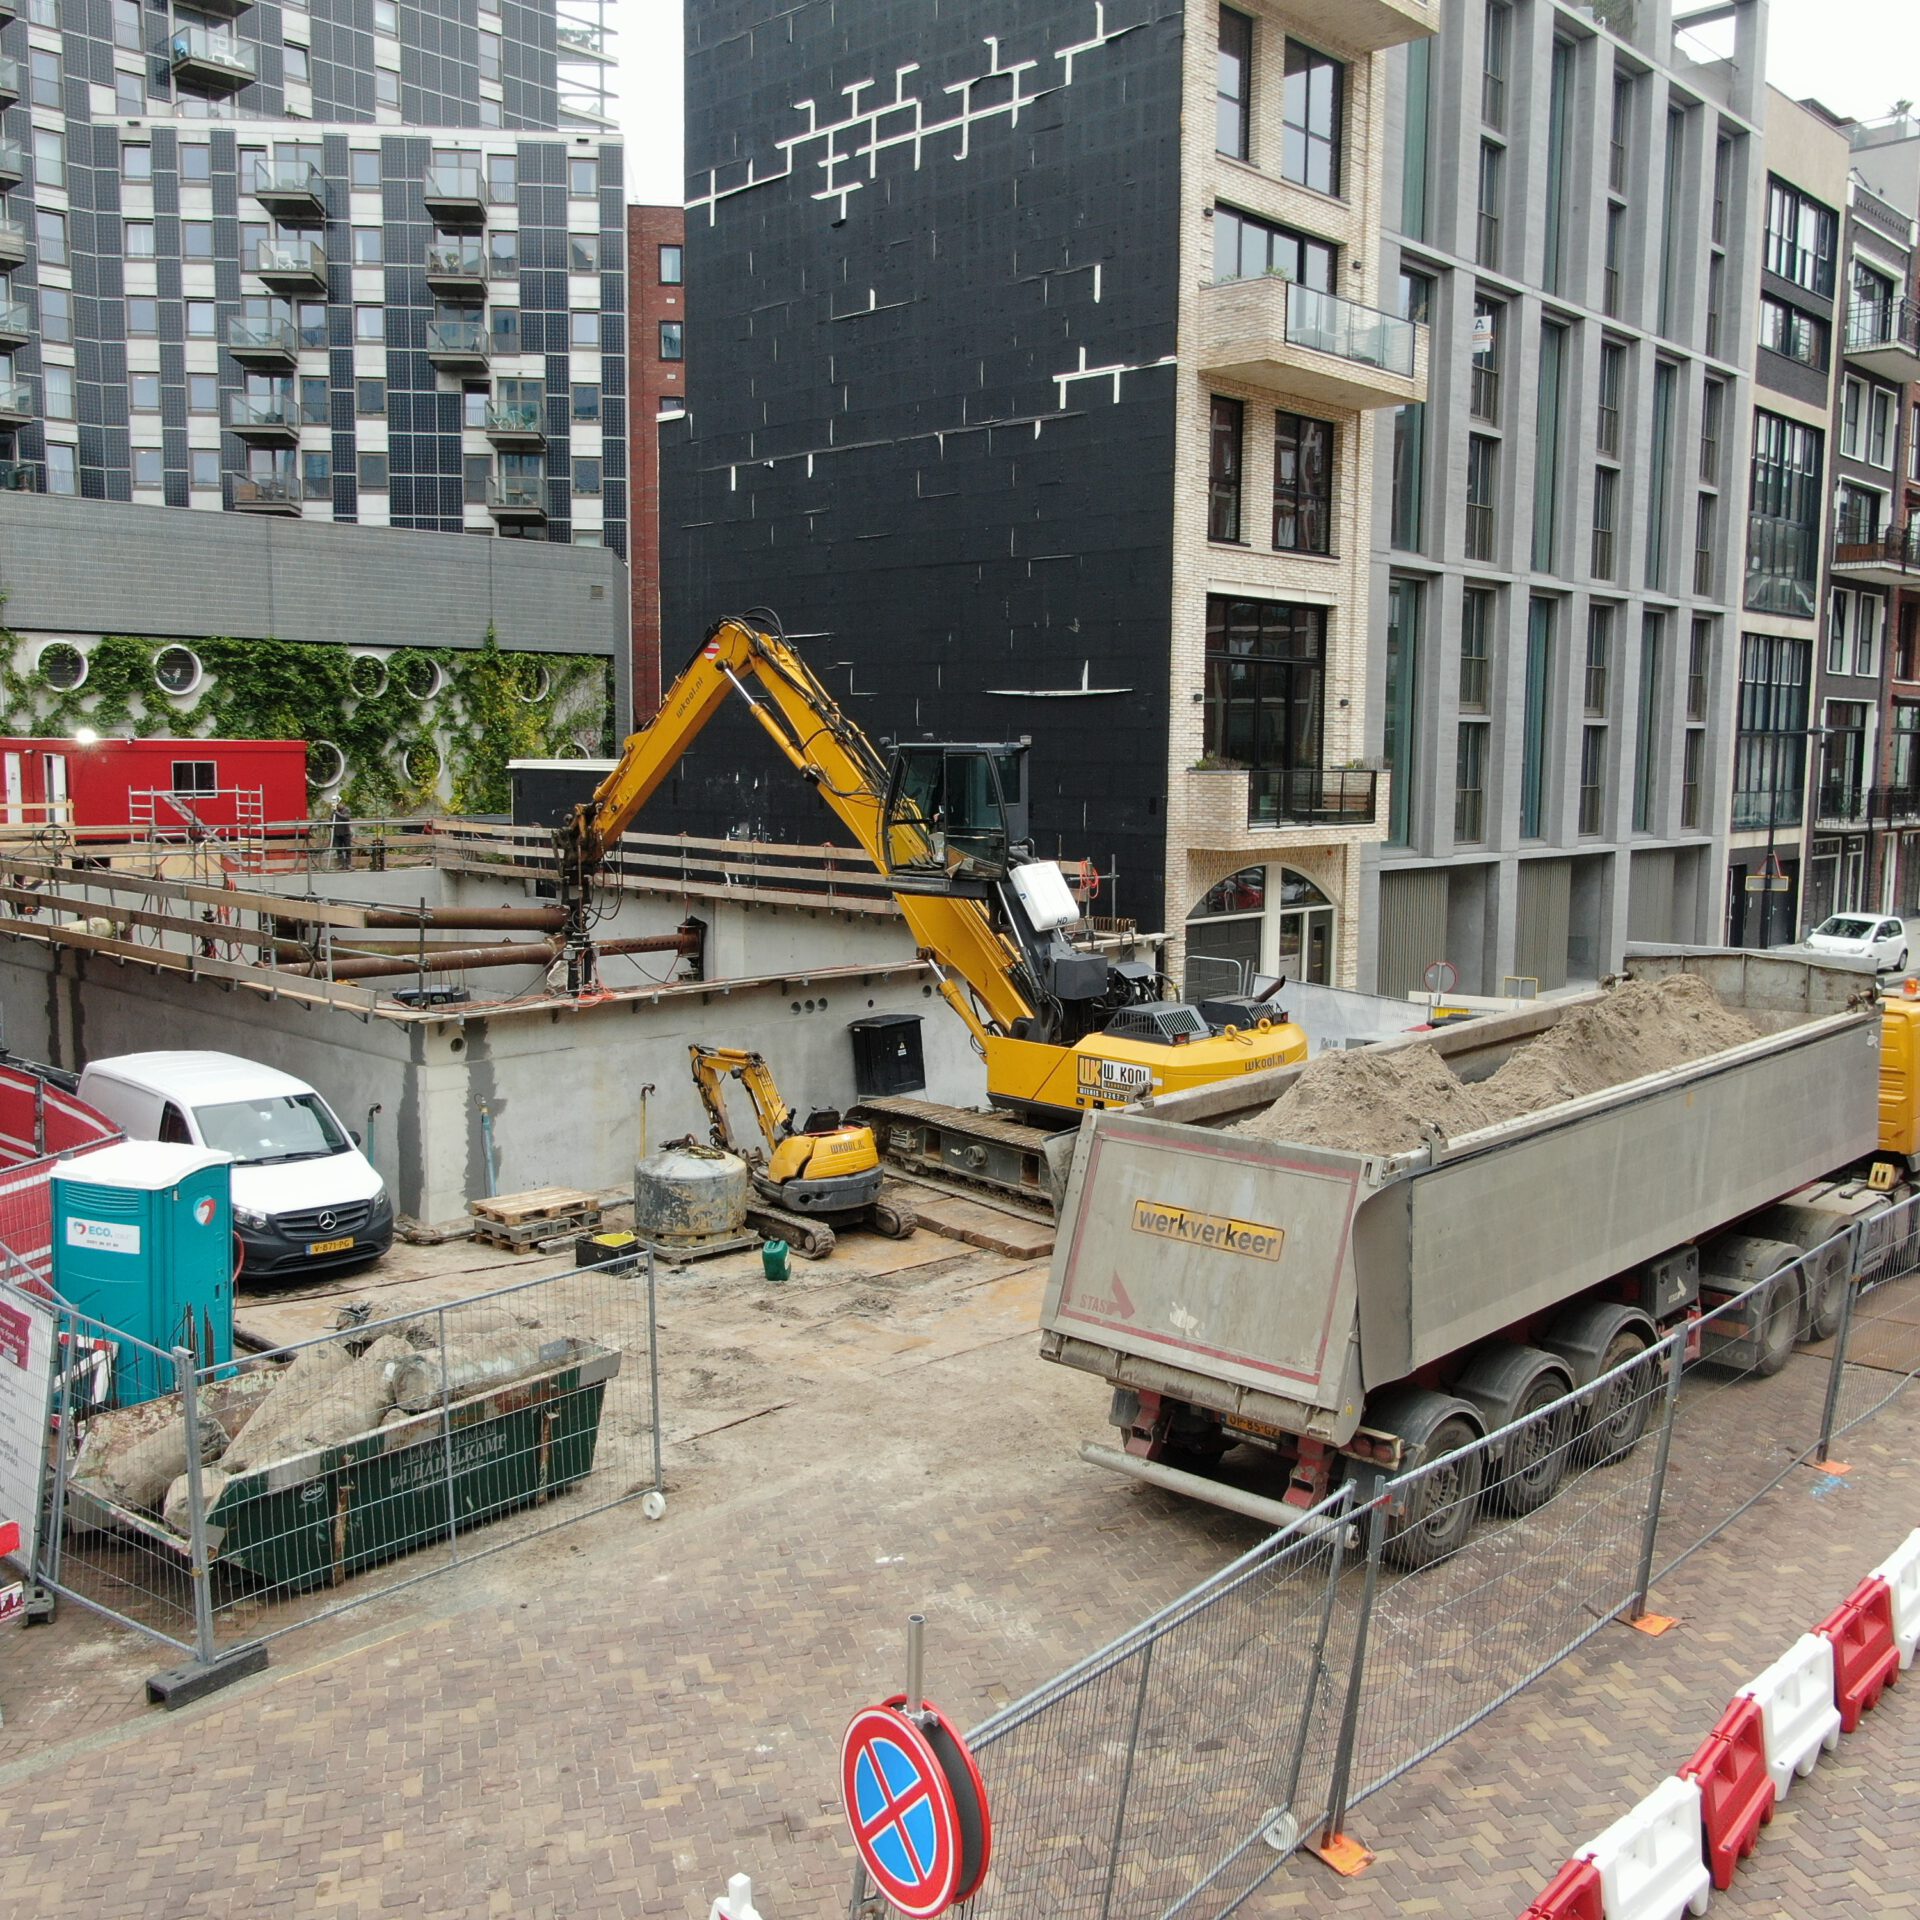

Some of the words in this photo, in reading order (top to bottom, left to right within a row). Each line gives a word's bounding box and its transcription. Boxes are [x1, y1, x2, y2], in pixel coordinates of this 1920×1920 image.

[676, 676, 704, 718] wkool.nl
[1056, 916, 1068, 926] HD
[1245, 1051, 1285, 1072] wkool.nl
[1140, 1210, 1276, 1255] werkverkeer
